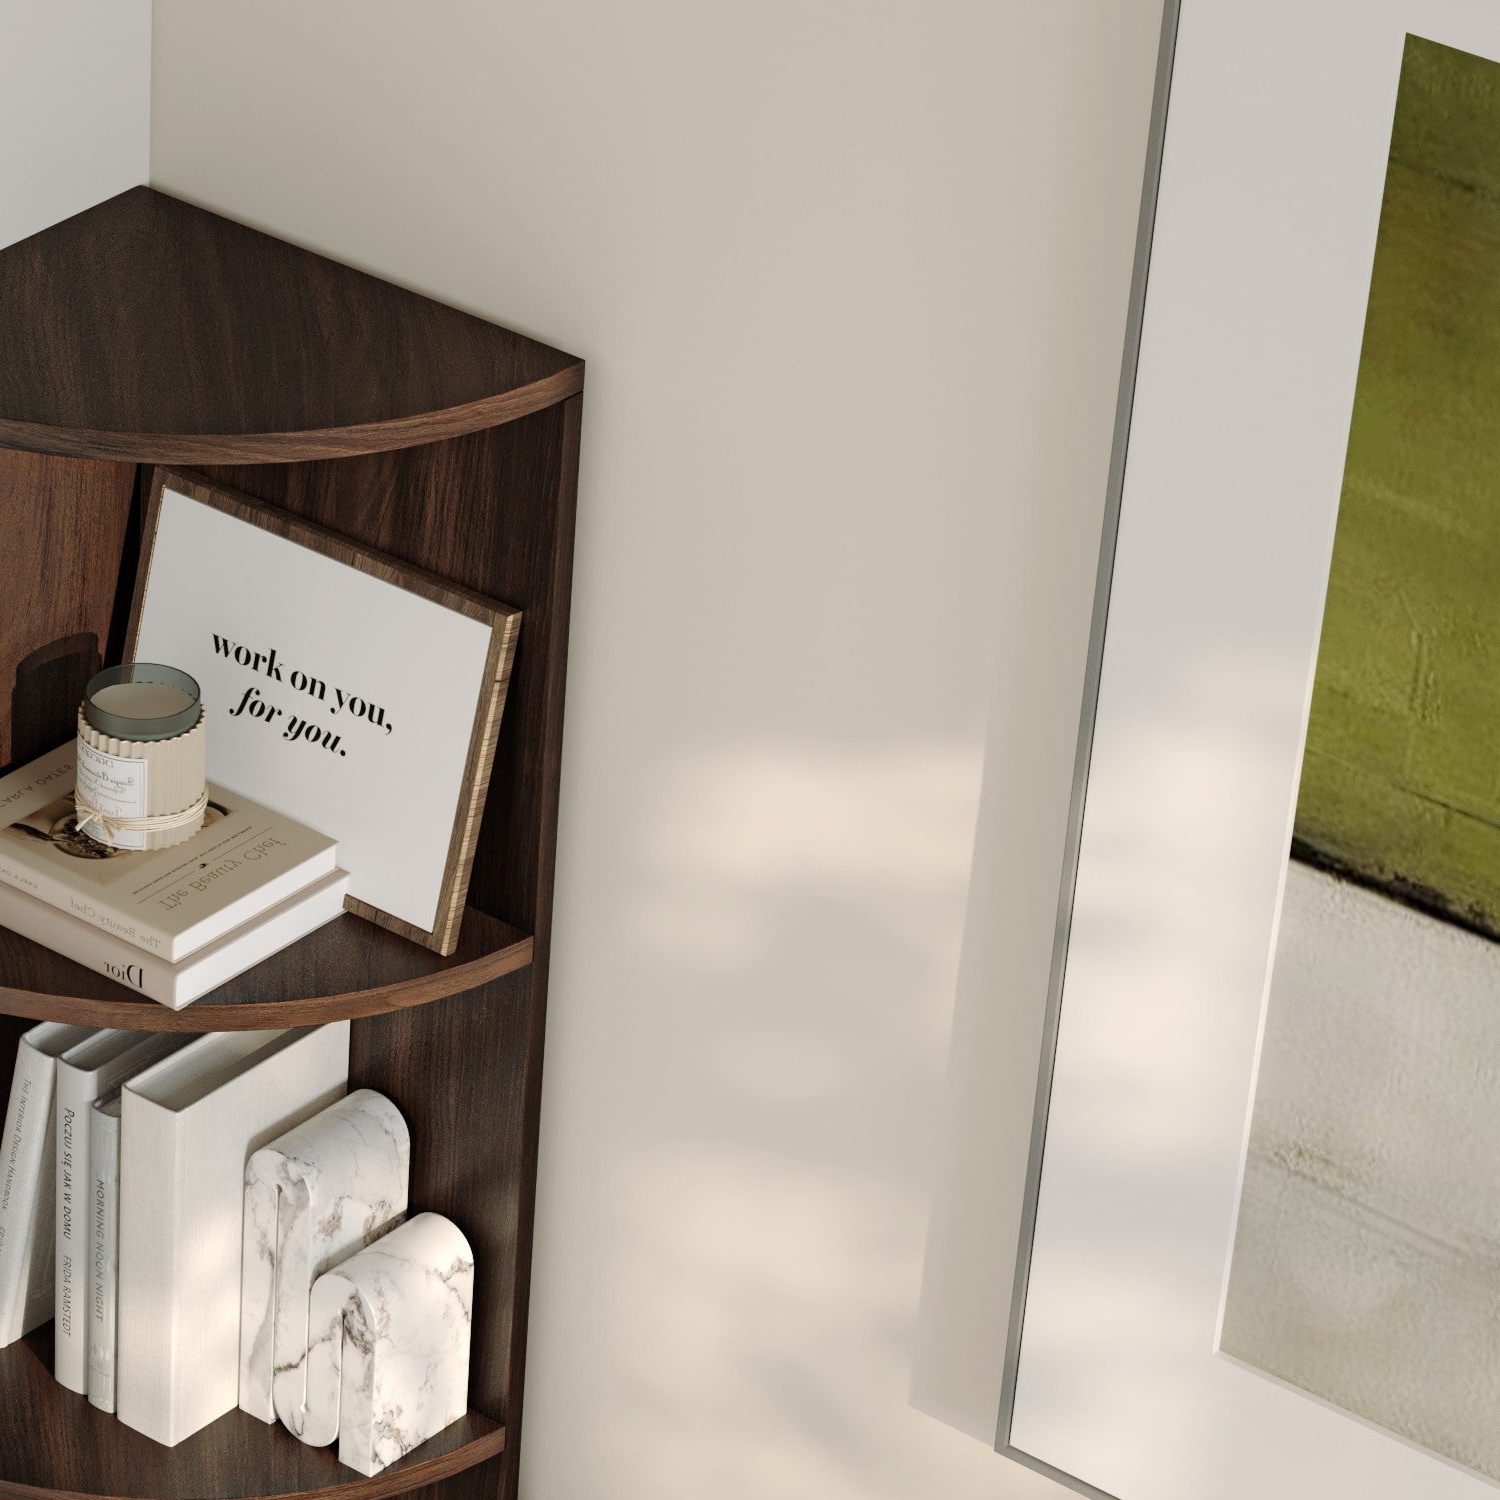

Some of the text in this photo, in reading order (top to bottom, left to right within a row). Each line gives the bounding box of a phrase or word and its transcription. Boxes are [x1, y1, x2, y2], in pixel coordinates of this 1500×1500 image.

[212, 632, 393, 736] work on you,
[229, 687, 346, 757] for you.
[63, 1107, 75, 1150] POCZUJ
[63, 1169, 72, 1191] JAK
[63, 1192, 72, 1205] W
[63, 1206, 72, 1240] DOMU
[95, 1178, 106, 1322] MORNING NOON NIGHT
[62, 1255, 72, 1337] FRIDA RAMSTEDT
